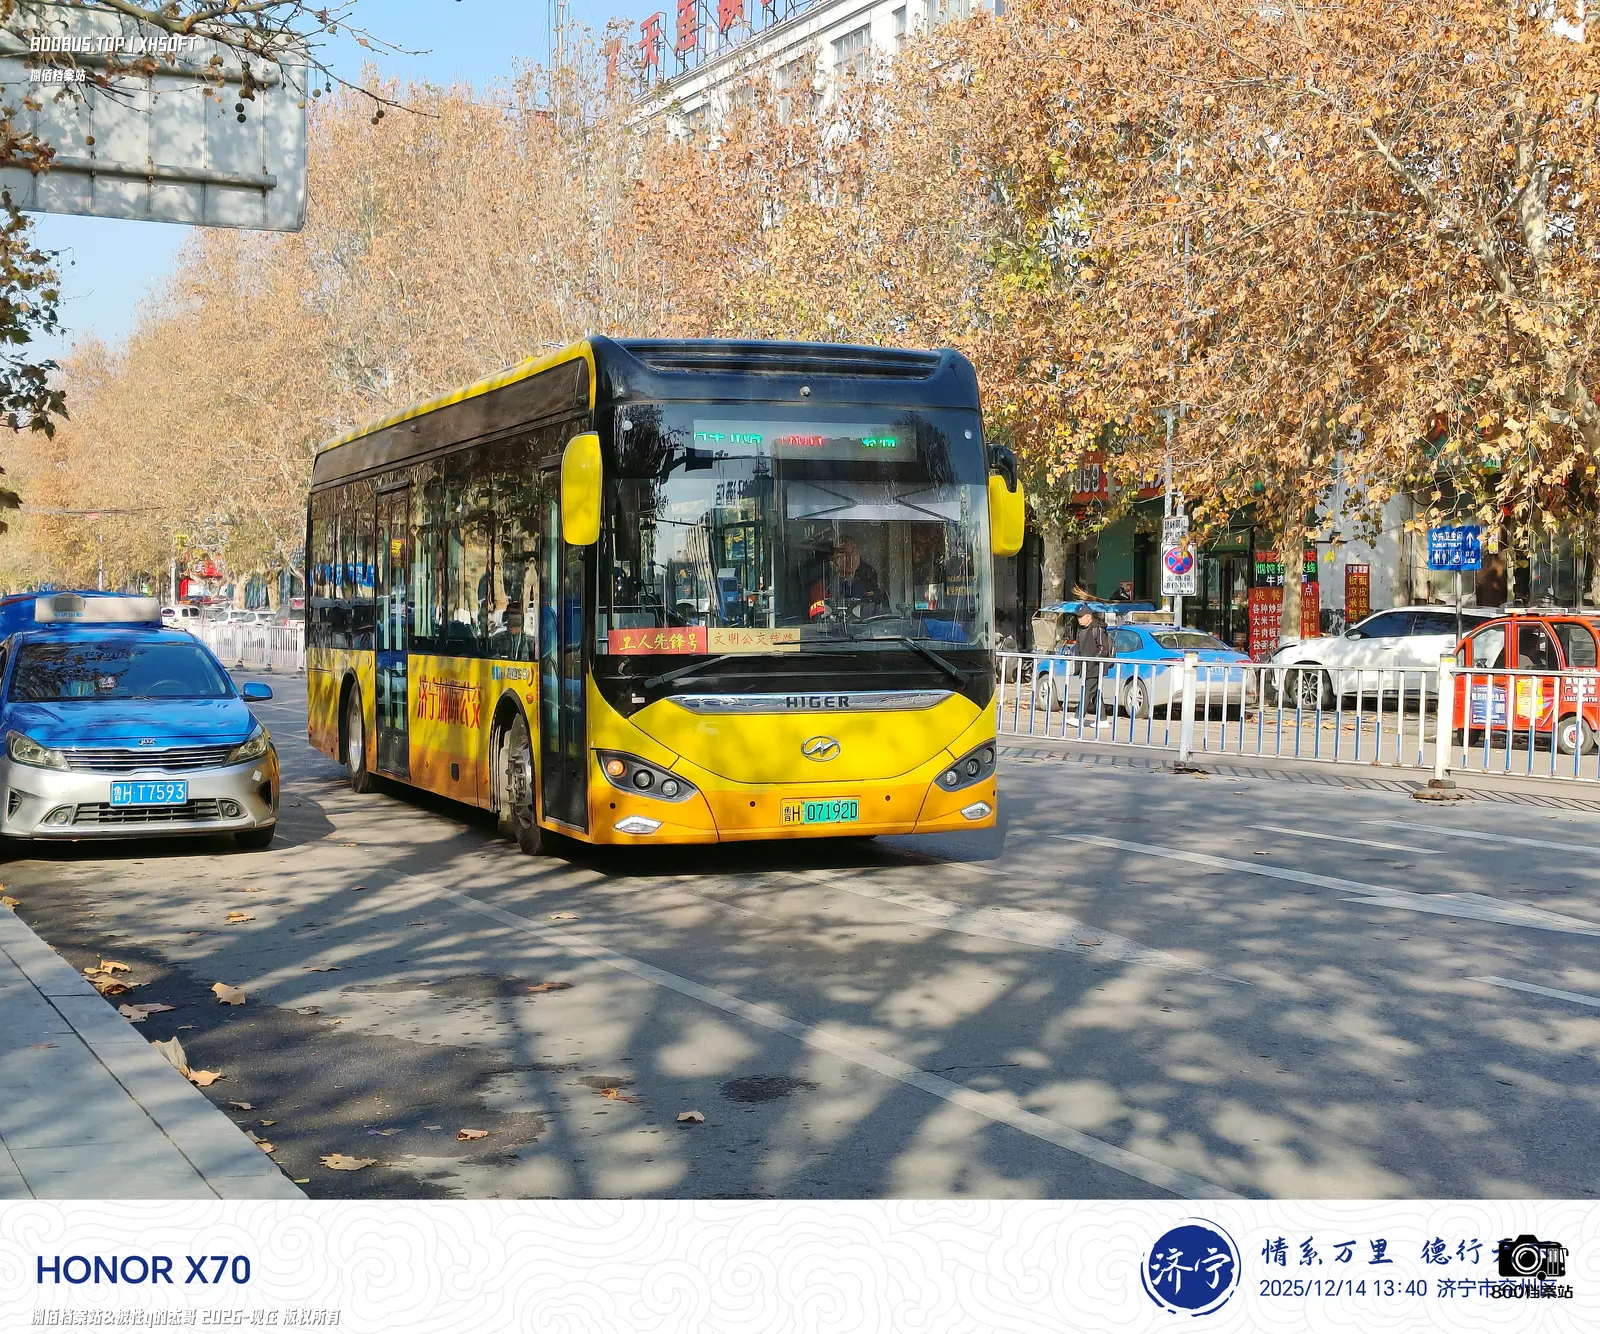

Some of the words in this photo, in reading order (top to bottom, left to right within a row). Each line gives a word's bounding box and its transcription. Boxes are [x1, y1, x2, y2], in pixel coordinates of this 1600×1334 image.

[619, 633, 699, 652] 工人先锋号
[714, 631, 796, 646] 文明公交线路
[786, 696, 850, 709] HIGER
